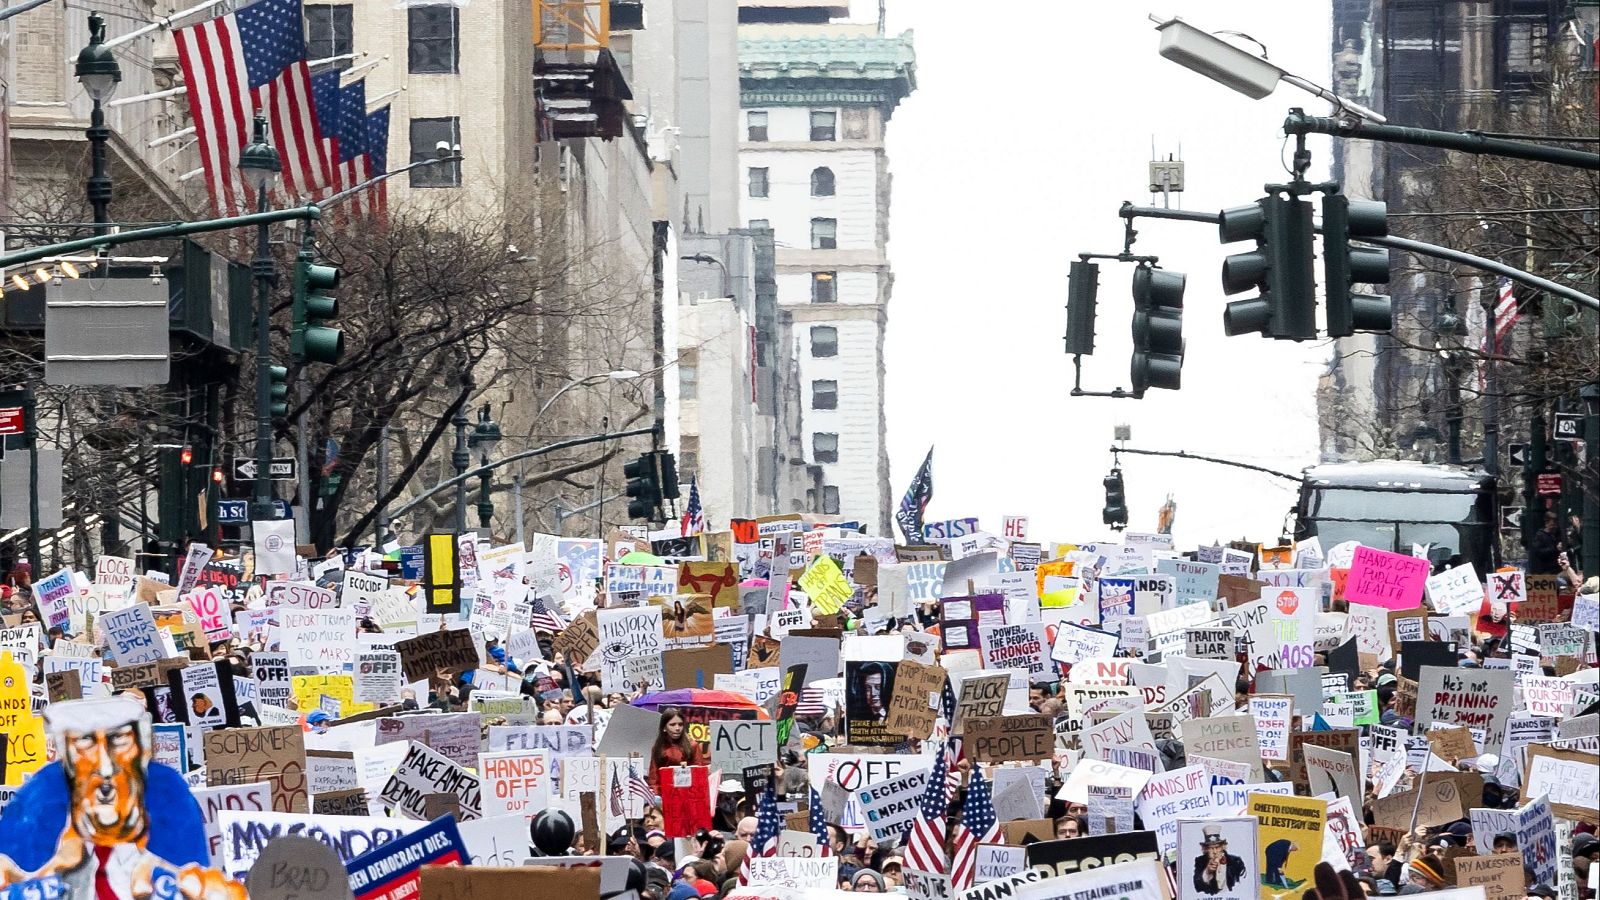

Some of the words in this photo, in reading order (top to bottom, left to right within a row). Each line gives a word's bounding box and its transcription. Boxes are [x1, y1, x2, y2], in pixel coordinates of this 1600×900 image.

[272, 465, 289, 473] WAY
[230, 505, 244, 518] St
[733, 522, 756, 543] NO
[760, 523, 799, 533] PROTECT
[925, 517, 979, 538] ESIST
[1005, 518, 1026, 538] HE
[98, 558, 130, 575] LOCK
[1175, 563, 1208, 575] TRUMP
[1357, 549, 1394, 569] HANDS
[1395, 558, 1425, 574] OFF!
[98, 574, 131, 586] TRUMP
[654, 569, 663, 580] A
[1363, 567, 1409, 587] PUBLIC
[41, 575, 67, 592] TRANS
[350, 577, 381, 593] ECOCIDE
[1134, 580, 1167, 591] ANDS
[1526, 577, 1556, 591] Seen
[287, 587, 331, 609] STOP
[1277, 596, 1298, 608] STOP
[105, 608, 143, 630] LITTLE
[285, 614, 320, 628] DEPORT
[324, 614, 352, 625] TRUMP
[777, 609, 802, 618] HANDS
[778, 616, 803, 626] OFF!
[27, 627, 34, 638] A
[110, 621, 156, 641] TRUMPS
[603, 613, 659, 639] HISTORY
[992, 626, 1022, 639] POWER
[1272, 619, 1299, 641] THE
[296, 632, 317, 643] AND
[320, 631, 345, 641] MUSK
[631, 633, 658, 649] HAS
[989, 637, 1004, 648] THE
[1006, 632, 1035, 645] PEOPLE
[1187, 630, 1232, 642] TRAITOR
[116, 634, 154, 655] BITCH
[989, 641, 1042, 663] STRONGER
[1067, 639, 1101, 654] TRUMP
[1196, 644, 1226, 655] LIAR
[255, 658, 287, 667] HANDS
[299, 648, 313, 660] TO
[320, 648, 351, 661] MARS
[1003, 655, 1032, 668] PEOPLE
[112, 664, 157, 685] RESIST
[256, 667, 289, 682] OFF!
[360, 662, 397, 675] OFF!
[898, 665, 918, 677] STOP
[1443, 673, 1465, 692] He's
[1470, 680, 1488, 692] not
[1526, 678, 1559, 688] HANDS
[259, 687, 290, 698] WORKER
[963, 681, 1003, 701] FUCK
[1528, 690, 1549, 700] OUR
[1252, 701, 1288, 709] TRUMP
[1434, 691, 1498, 709] DRAINING
[959, 701, 1001, 718] THIS!
[1430, 708, 1451, 721] the
[1201, 721, 1242, 738] MORE
[1258, 720, 1285, 728] OSER
[1510, 720, 1539, 729] HANDS
[209, 728, 294, 756] SCHUMER
[506, 731, 587, 753] FUND
[716, 722, 772, 751] ACT
[1294, 733, 1352, 749] RESIST
[976, 734, 1047, 759] PEOPLE
[1193, 736, 1252, 754] SCIENCE
[484, 756, 545, 780] HANDS
[836, 758, 901, 793] OFF
[255, 761, 305, 794] GO
[402, 746, 446, 781] MAKE
[433, 764, 481, 810] AMERIC
[1141, 774, 1186, 800] HANDS
[1186, 770, 1205, 791] OFF
[496, 778, 538, 798] OFF
[860, 773, 926, 805] DECENCY
[1088, 785, 1113, 795] HANDS
[1156, 801, 1177, 818] FREE
[1179, 795, 1211, 811] SPEECH
[1254, 803, 1280, 814] CHEETO
[1281, 805, 1321, 818] ECONOMICS
[1472, 812, 1515, 832] HANDS
[1519, 803, 1546, 827] Make
[1517, 816, 1551, 845] Tyranny
[369, 841, 426, 882] DEMOCRACY
[990, 850, 1009, 863] NO
[1458, 859, 1472, 873] MY
[1475, 856, 1521, 870] ANCESTORS
[979, 865, 1017, 877] KINGS
[1074, 885, 1118, 900] STEALING
